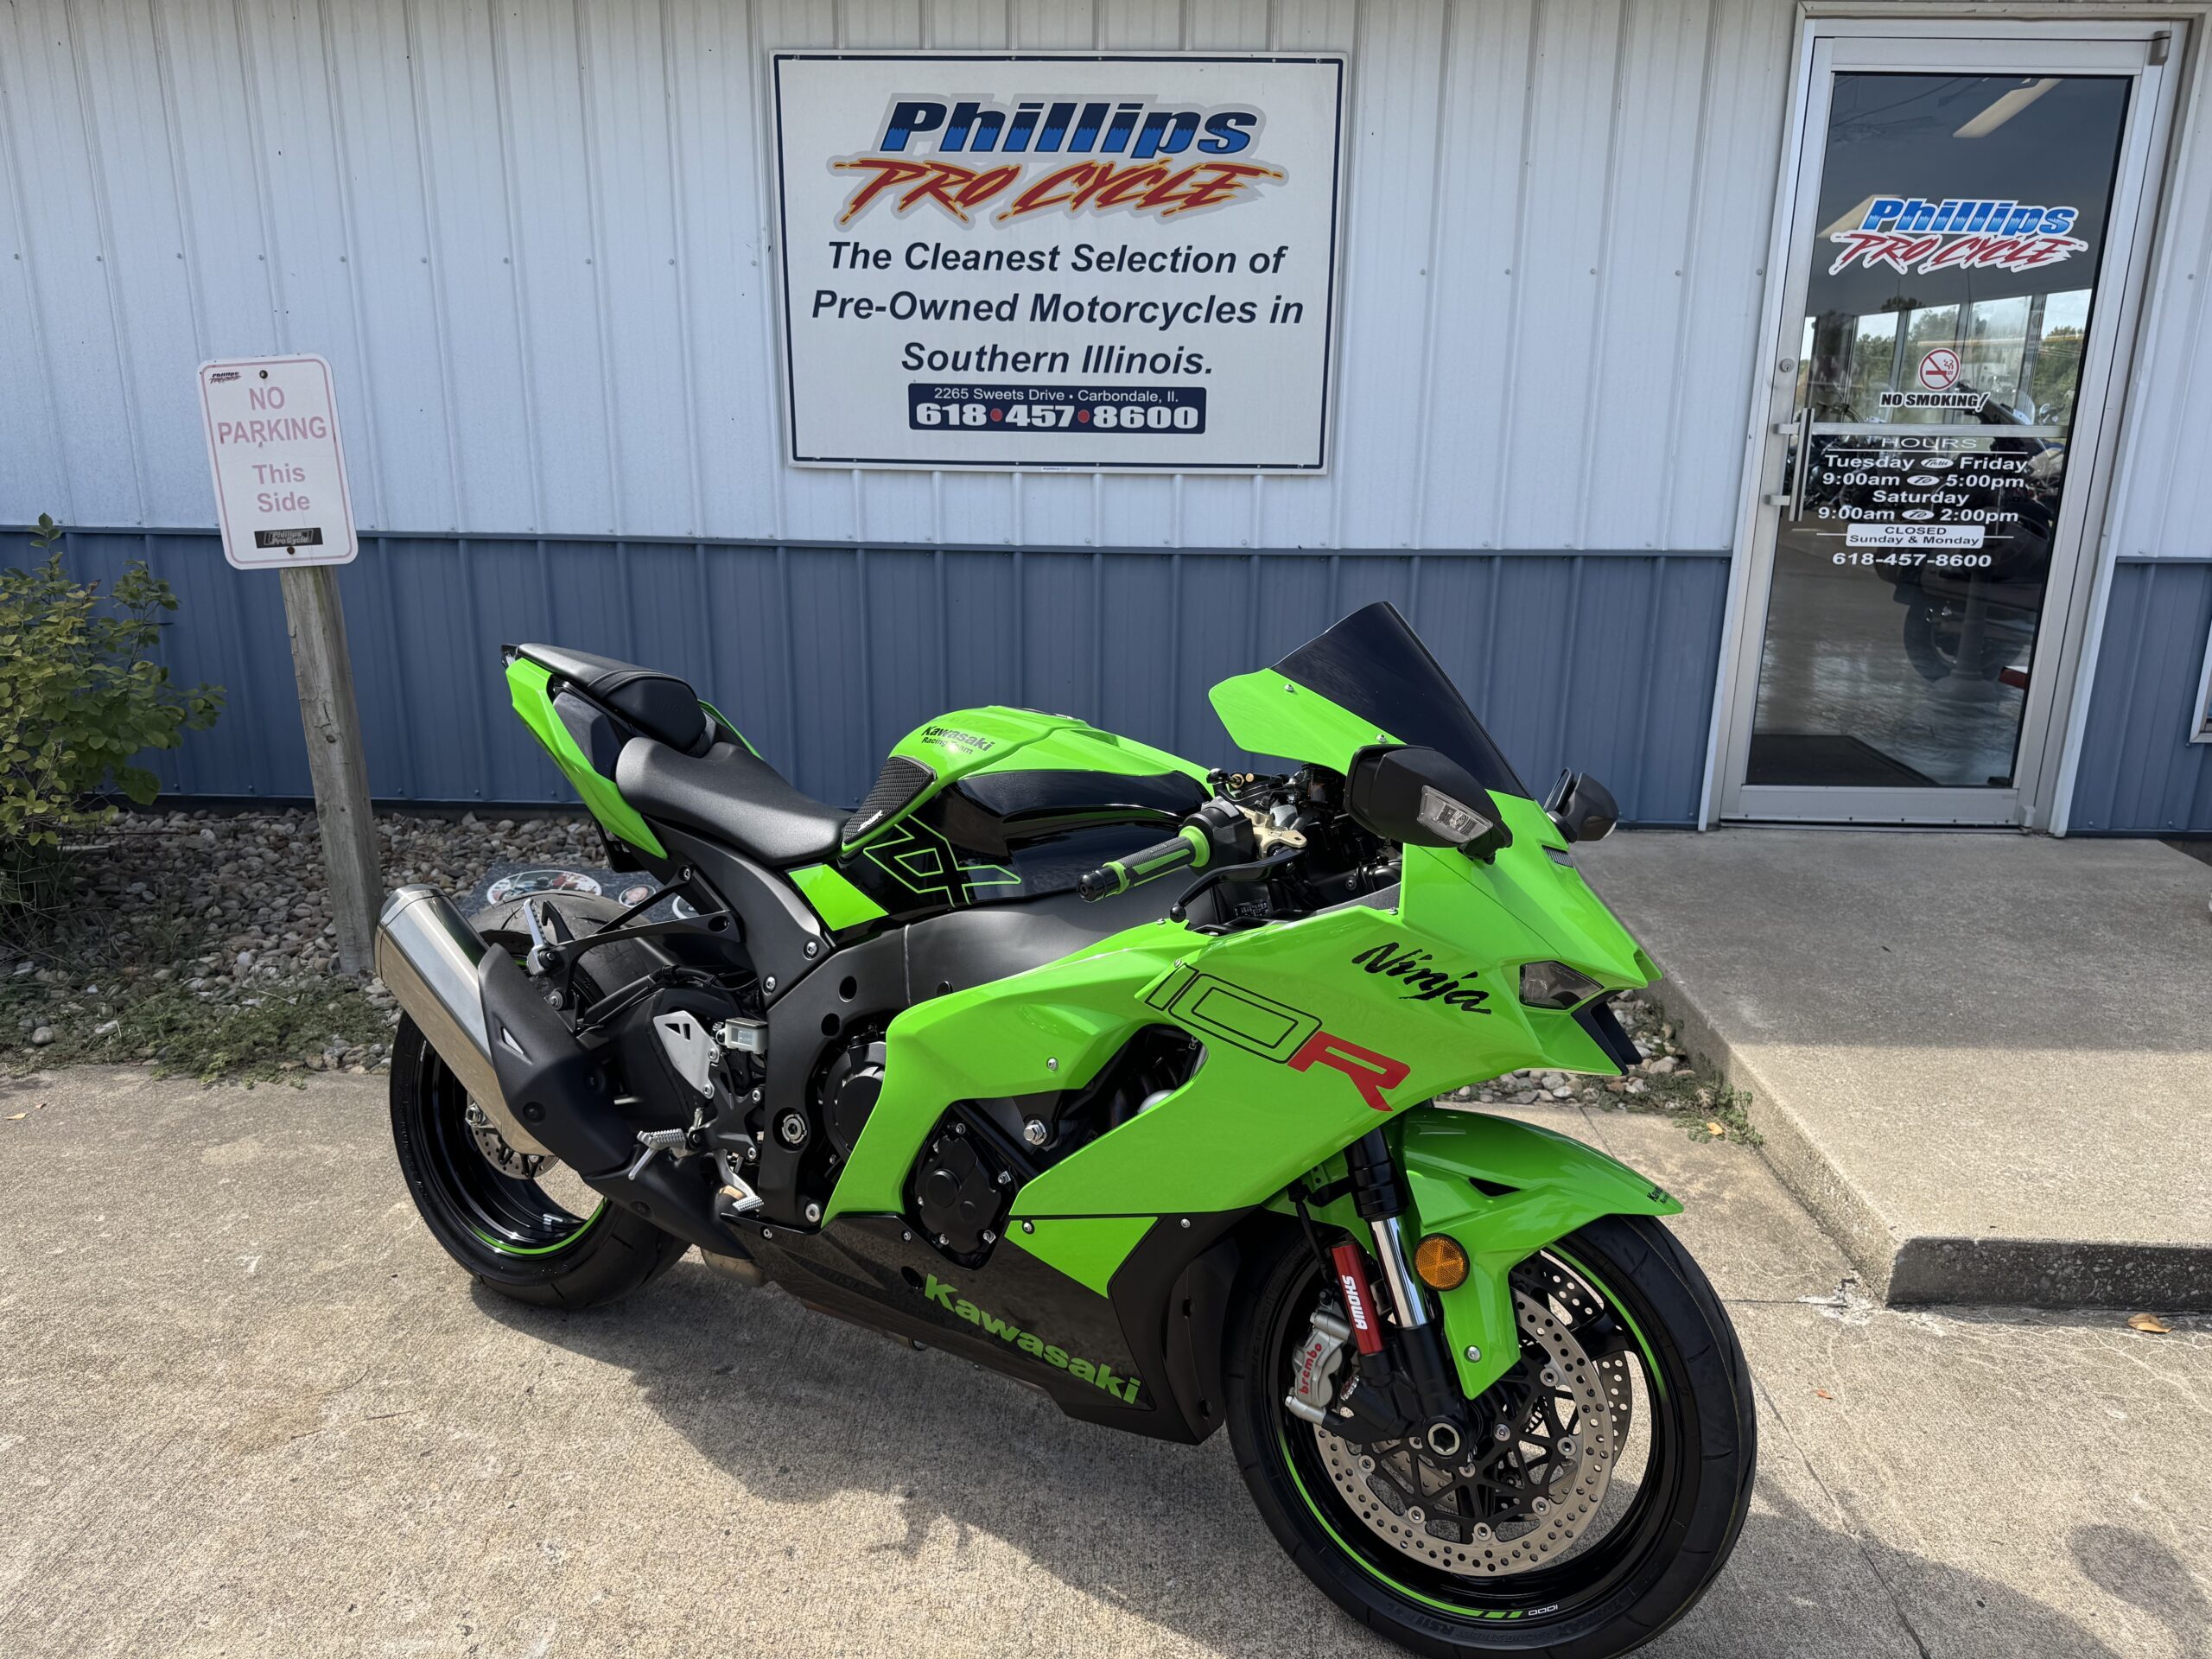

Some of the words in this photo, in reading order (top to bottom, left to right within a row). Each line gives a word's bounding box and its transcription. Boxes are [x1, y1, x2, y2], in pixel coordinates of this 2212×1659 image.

[880, 100, 1257, 158] Phillips
[834, 158, 1022, 224] PRO
[996, 158, 1285, 222] CYCLE
[1861, 199, 2076, 236] Phillips
[828, 242, 892, 270] The
[905, 242, 1060, 274] Cleanest
[1071, 245, 1237, 275] Selection
[1249, 246, 1287, 275] of
[1830, 232, 1940, 273] PRO
[1918, 234, 2088, 273] CYCLE
[811, 289, 1019, 323] Pre-Owned
[1029, 293, 1258, 331] Motorcycles
[1269, 296, 1303, 324] in
[901, 343, 1070, 374] Southern
[1081, 346, 1213, 375] Illinois.
[249, 386, 285, 410] NO
[934, 388, 969, 400] 2265
[974, 389, 1025, 400] Sweets
[1028, 390, 1065, 401] Drive
[1077, 391, 1162, 404] Carbondale,
[1880, 393, 1903, 406] NO
[1905, 392, 1990, 411] SMOKING!
[916, 403, 987, 426] 618
[1005, 404, 1075, 427] 457
[1092, 405, 1198, 429] 8600
[217, 416, 327, 444] PARKING
[1881, 437, 1977, 449] HOURS
[252, 463, 306, 485] This
[1825, 454, 1915, 471] Tuesday
[1960, 457, 2028, 474] Friday
[1822, 473, 1900, 486] 9:00am
[1915, 475, 1932, 486] To
[1945, 474, 2024, 490] 5:00pm
[257, 492, 310, 513] Side
[1872, 490, 1969, 506] Saturday
[1817, 507, 1895, 520] 9:00am
[1910, 510, 1928, 519] To
[1939, 509, 2019, 524] 2:00pm
[1849, 535, 1904, 545] Sunday
[1907, 536, 1918, 544] &
[1923, 536, 1980, 546] Monday
[1885, 526, 1947, 535] CLOSED
[1832, 552, 1992, 568] 618-457-8600
[921, 726, 995, 751] Kawasaki
[921, 737, 947, 747] Racing
[1351, 942, 1492, 1015] Ninja
[1342, 1274, 1369, 1331] SHOWA
[924, 1274, 1141, 1404] Kawasaki
[1299, 1343, 1323, 1395] brembo
